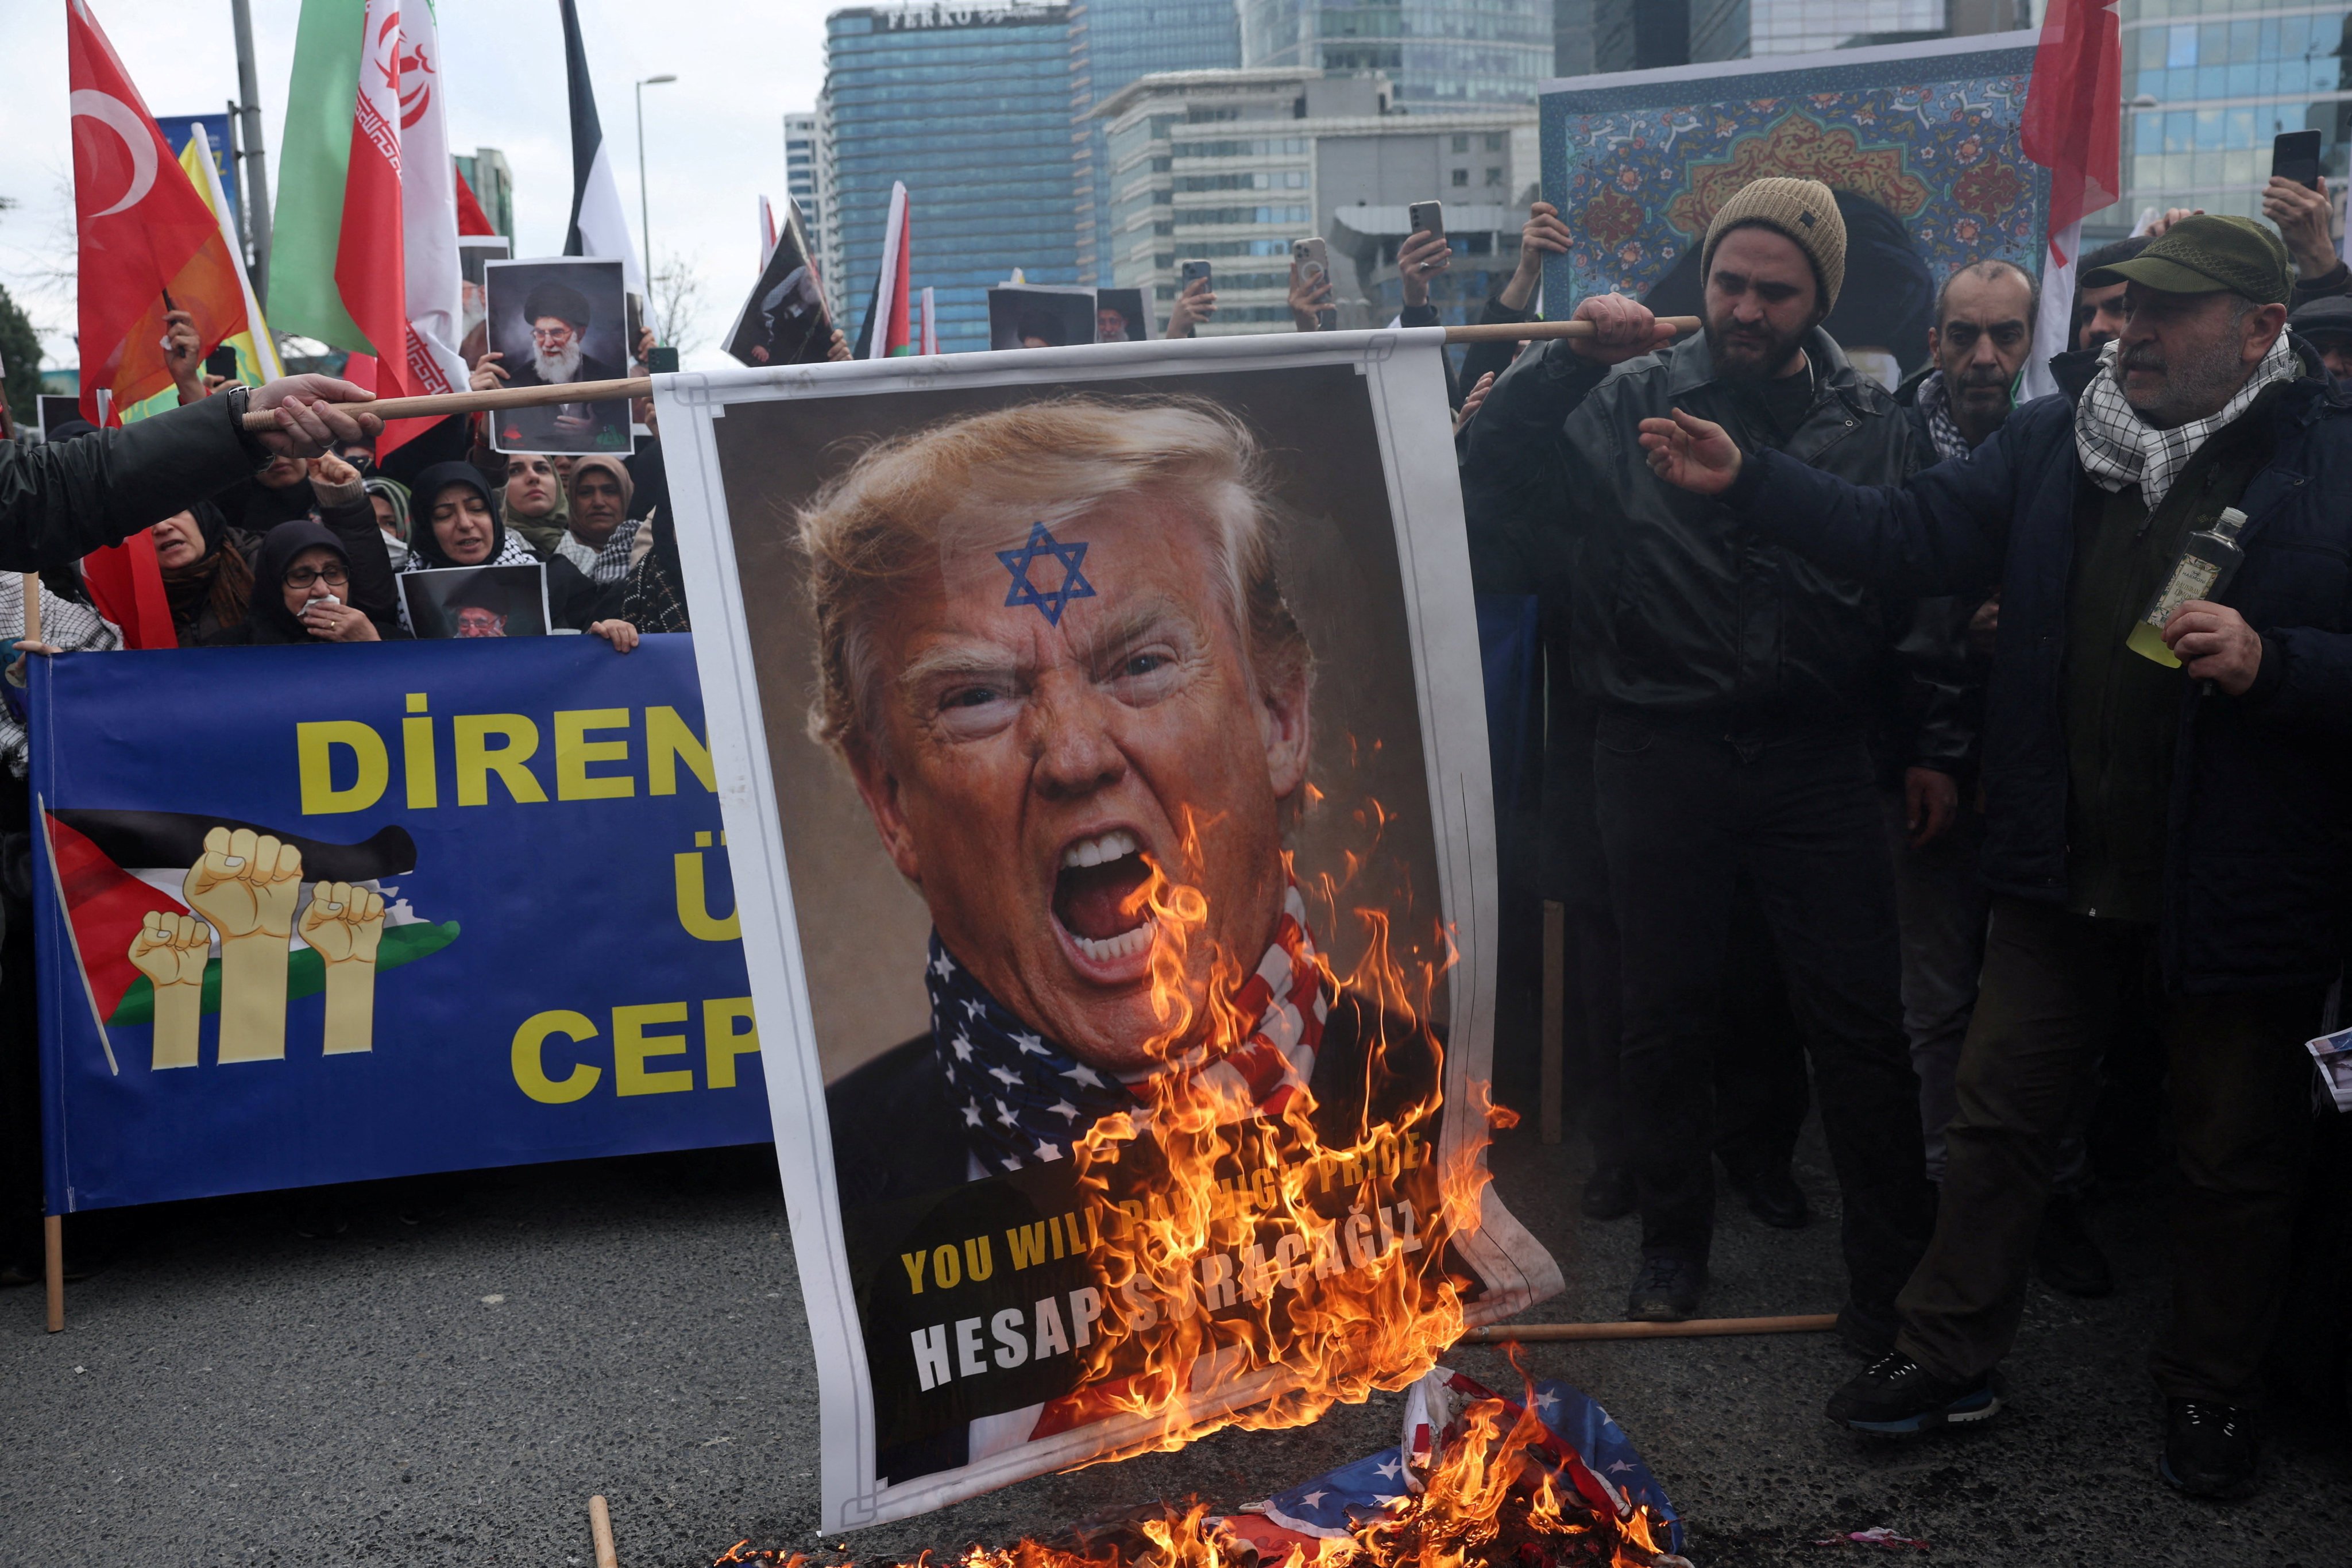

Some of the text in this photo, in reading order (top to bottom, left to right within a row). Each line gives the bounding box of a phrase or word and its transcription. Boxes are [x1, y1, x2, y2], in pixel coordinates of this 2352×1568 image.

[901, 1235, 993, 1295] YOU
[1006, 1207, 1105, 1270] WILL
[1320, 1132, 1420, 1194] PRICE
[911, 1199, 1423, 1392] HESAP SORACAĞIZ
